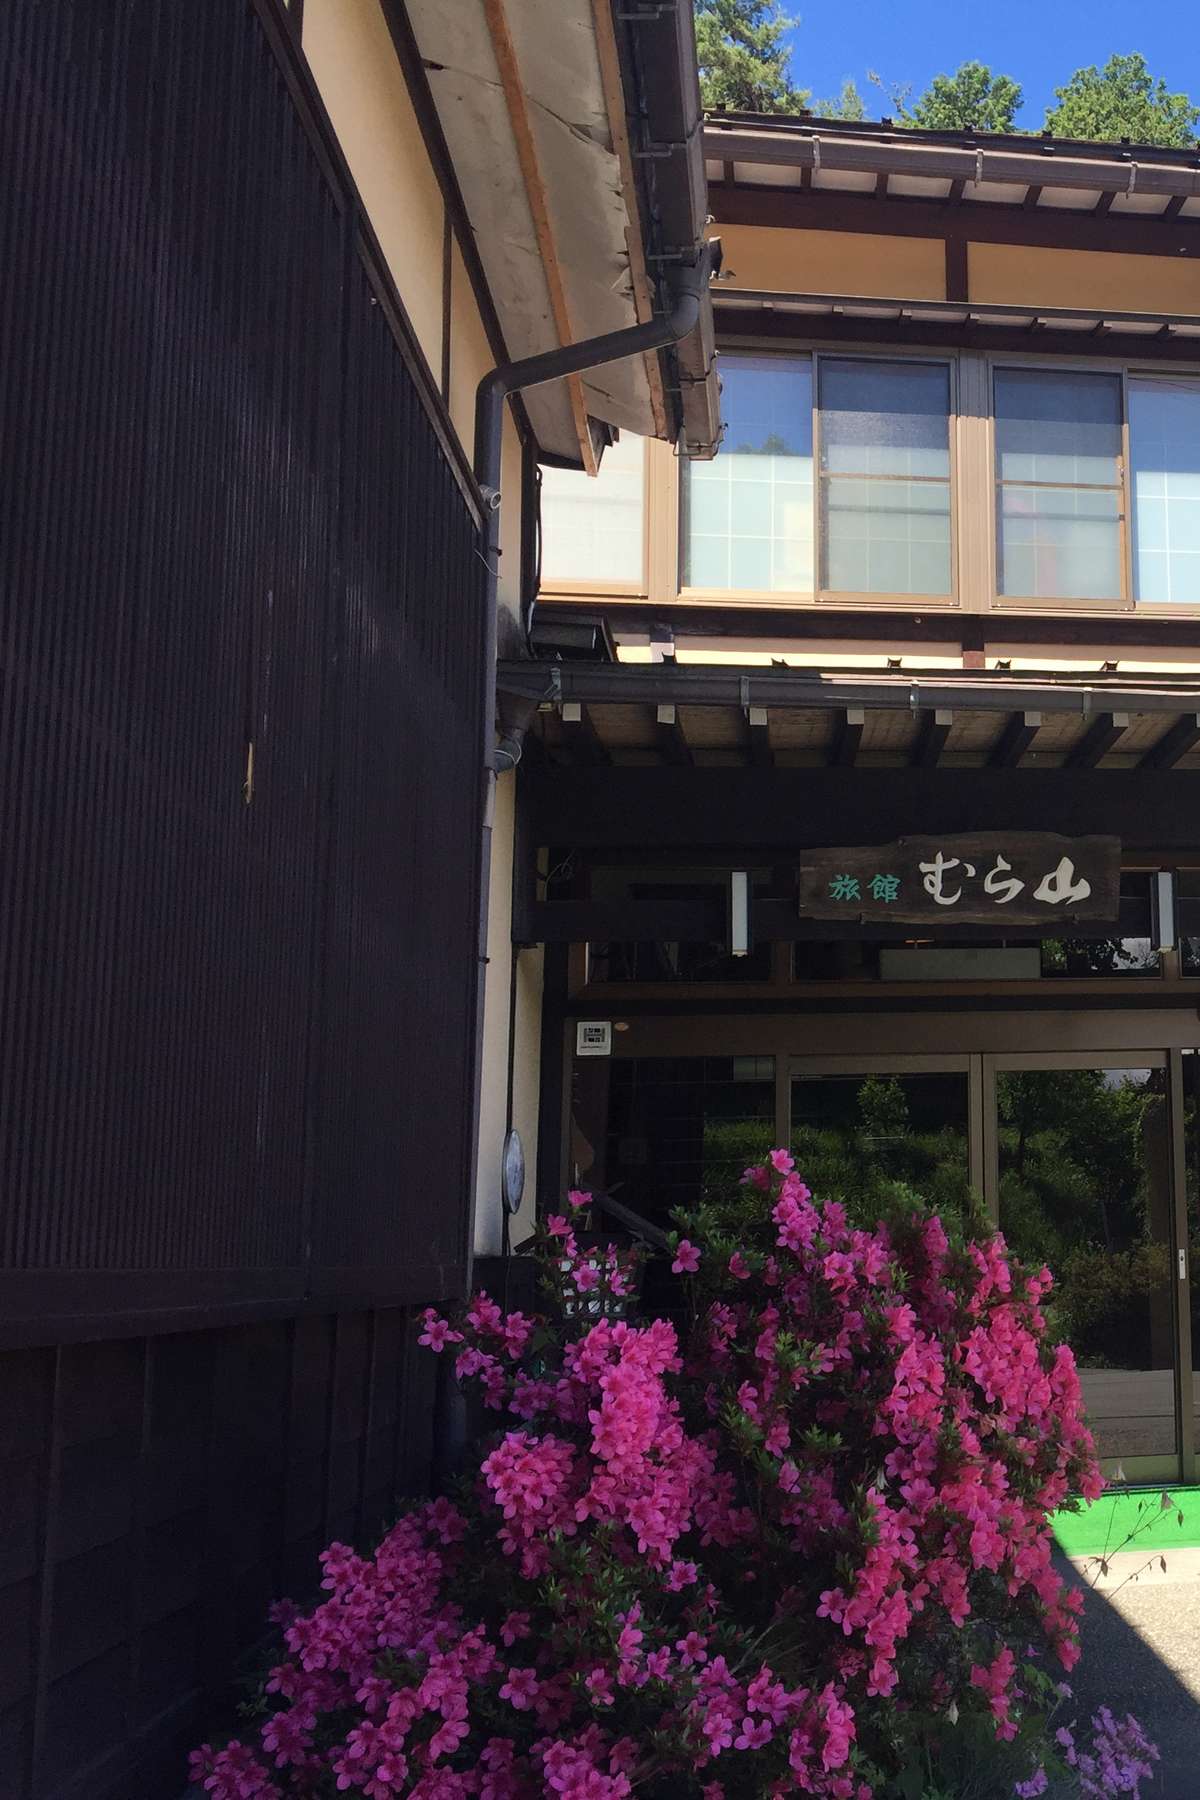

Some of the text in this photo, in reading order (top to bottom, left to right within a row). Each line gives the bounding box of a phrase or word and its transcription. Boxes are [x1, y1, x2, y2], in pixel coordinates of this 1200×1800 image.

[828, 850, 1092, 905] 旅館 むら山
